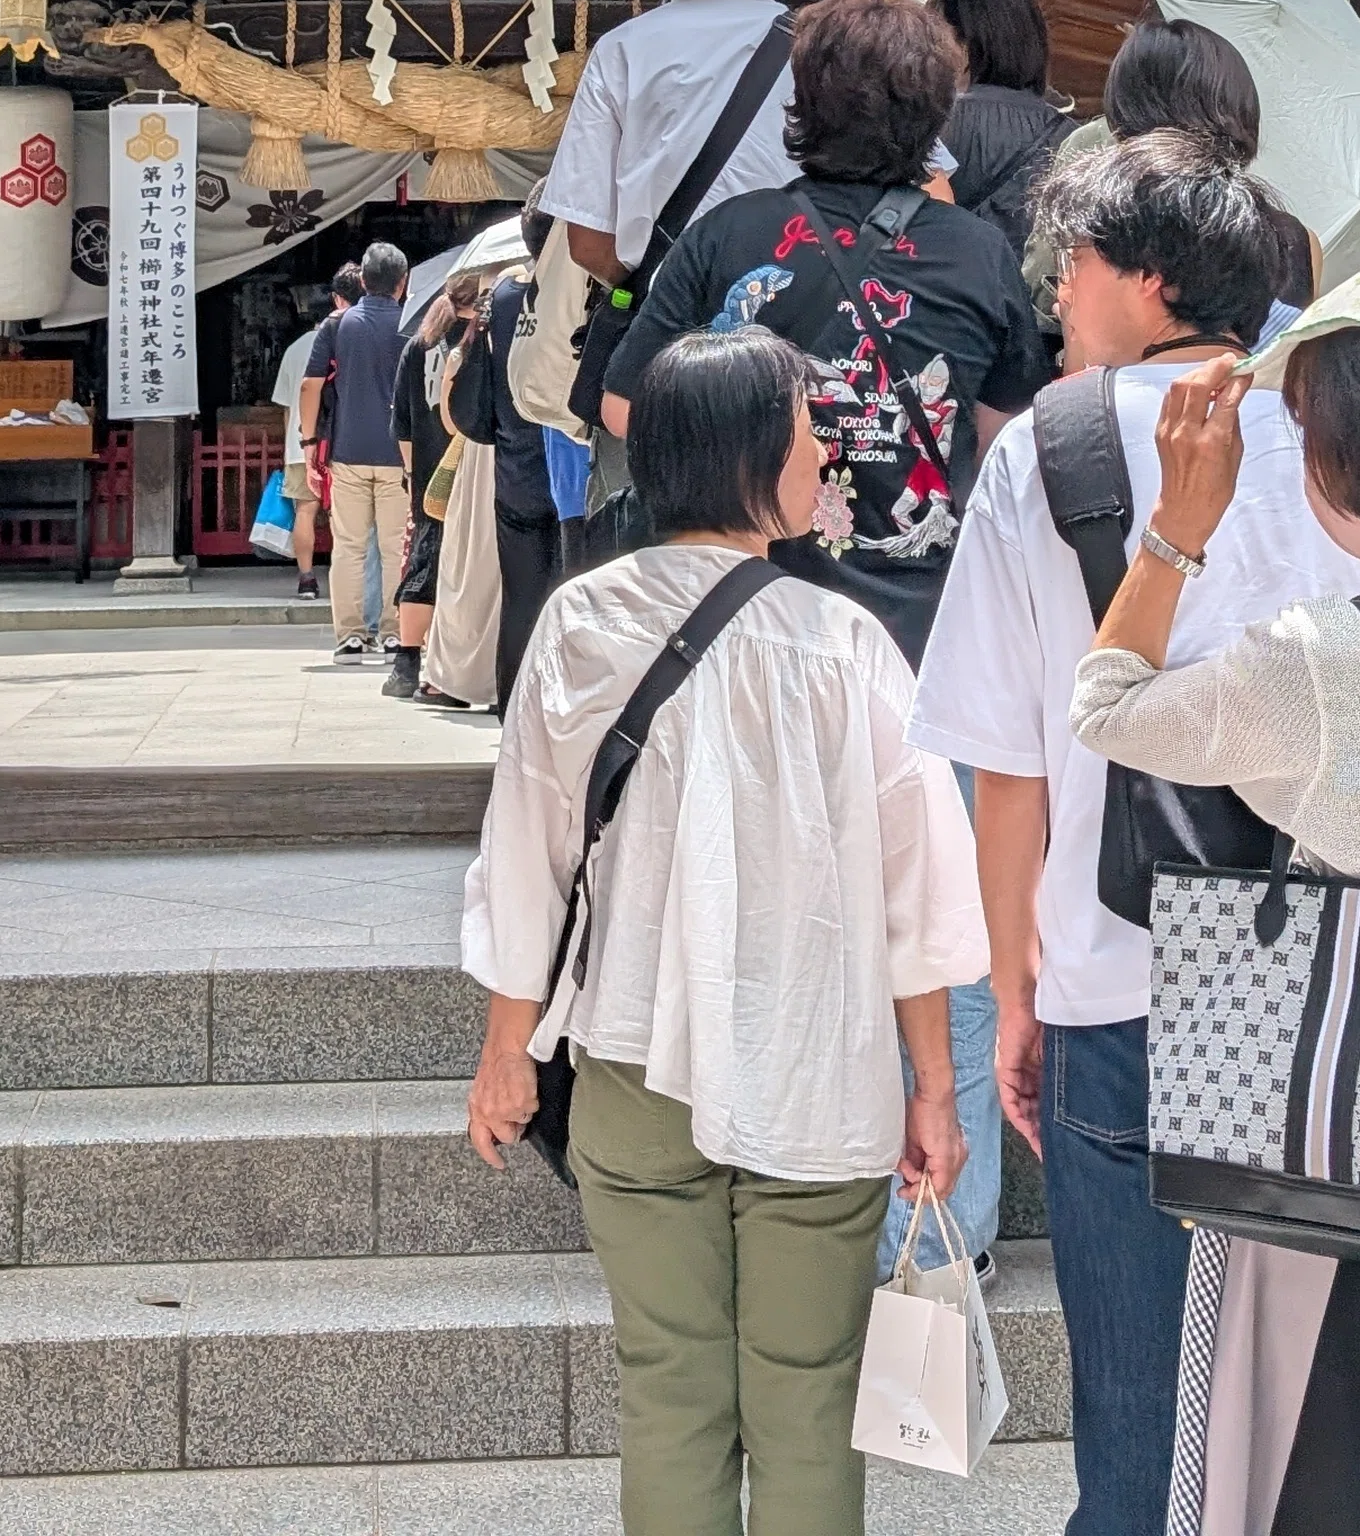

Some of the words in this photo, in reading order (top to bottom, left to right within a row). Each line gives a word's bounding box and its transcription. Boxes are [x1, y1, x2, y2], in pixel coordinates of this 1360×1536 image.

[169, 162, 188, 360] うけつぐ博多のこころ
[831, 358, 873, 372] AOMORI
[836, 416, 872, 428] TOKYO
[846, 449, 898, 463] YOKOSUKA
